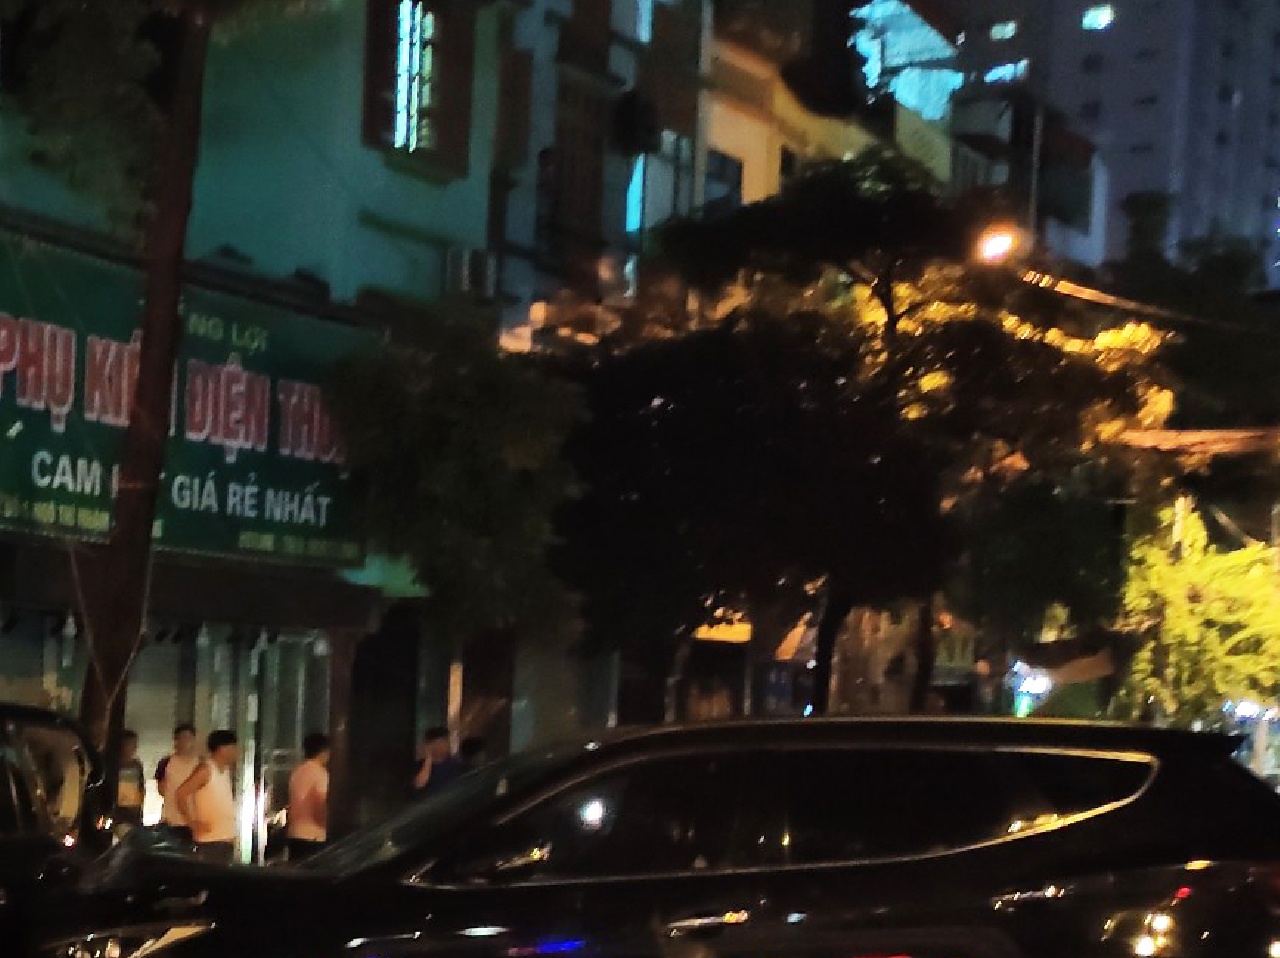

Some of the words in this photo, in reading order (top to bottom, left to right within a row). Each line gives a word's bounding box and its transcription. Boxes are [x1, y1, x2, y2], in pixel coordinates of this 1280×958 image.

[184, 352, 270, 464] ĐIỆN
[31, 450, 102, 496] CAM
[171, 471, 219, 513] GIÁ
[226, 473, 259, 518] RẺ
[265, 481, 332, 528] NHẤT
